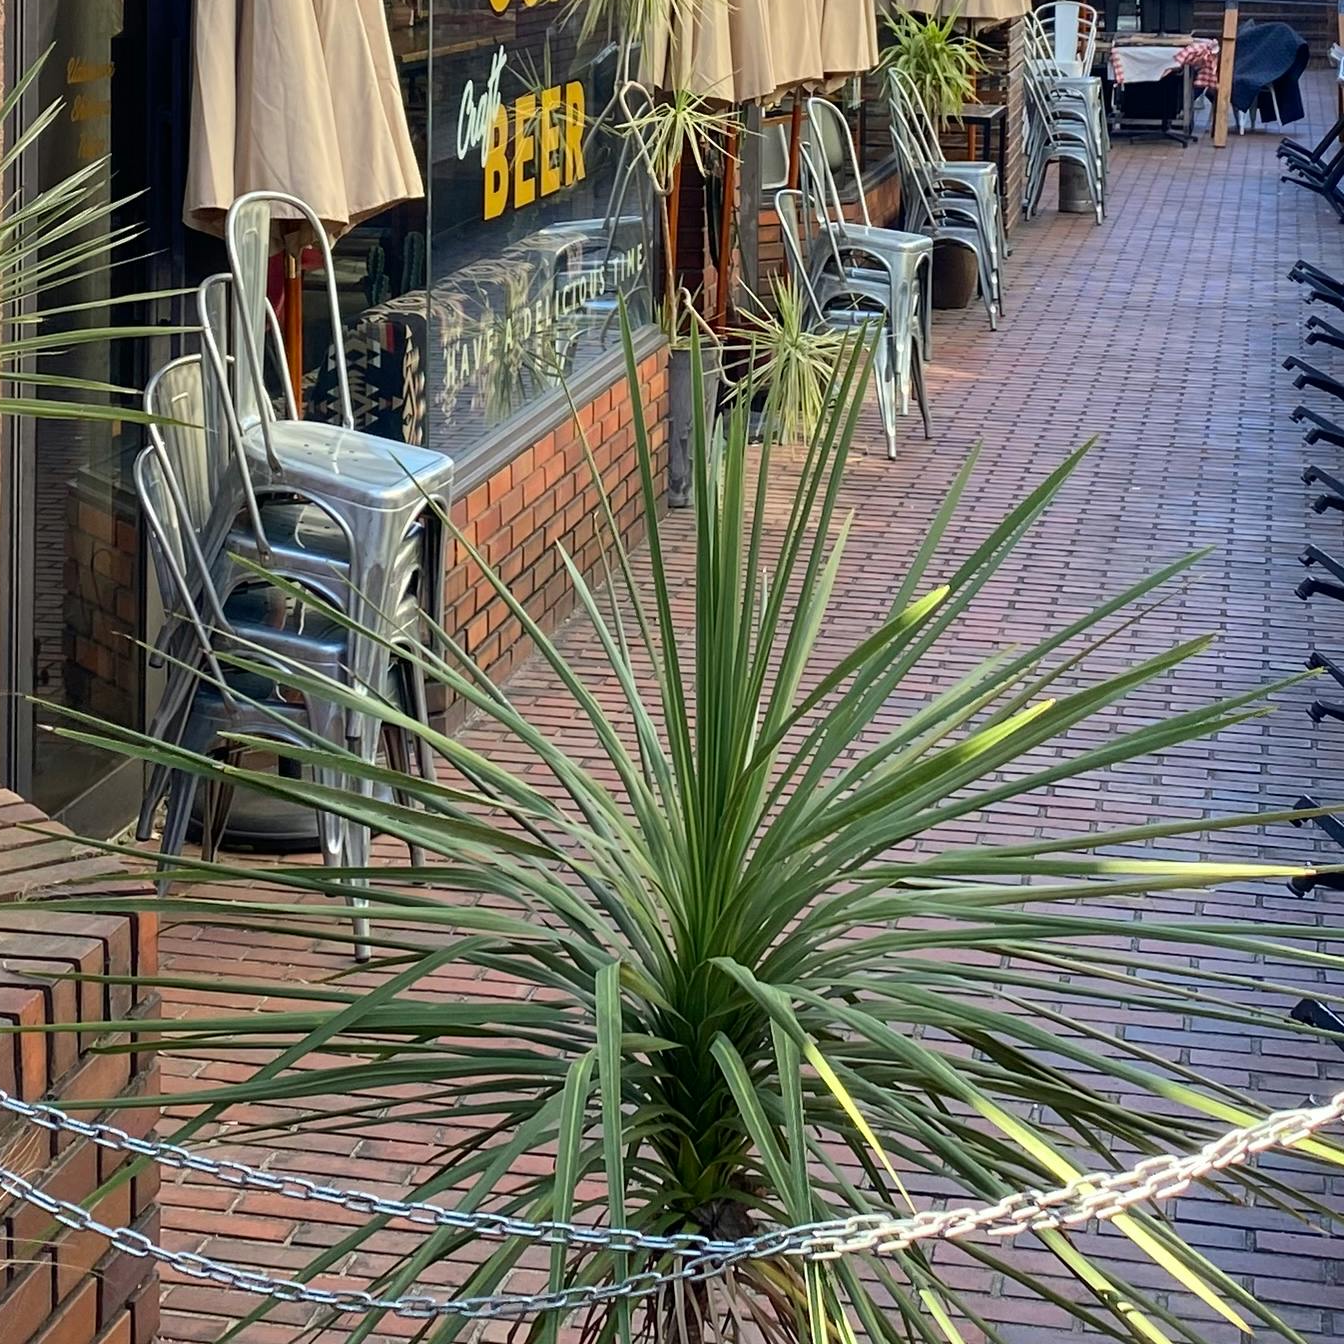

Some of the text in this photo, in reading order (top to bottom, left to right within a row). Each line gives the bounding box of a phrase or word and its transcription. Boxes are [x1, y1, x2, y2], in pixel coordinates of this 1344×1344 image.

[457, 45, 507, 168] Craft
[484, 81, 586, 221] BEER
[523, 265, 605, 340] DELICIOUS
